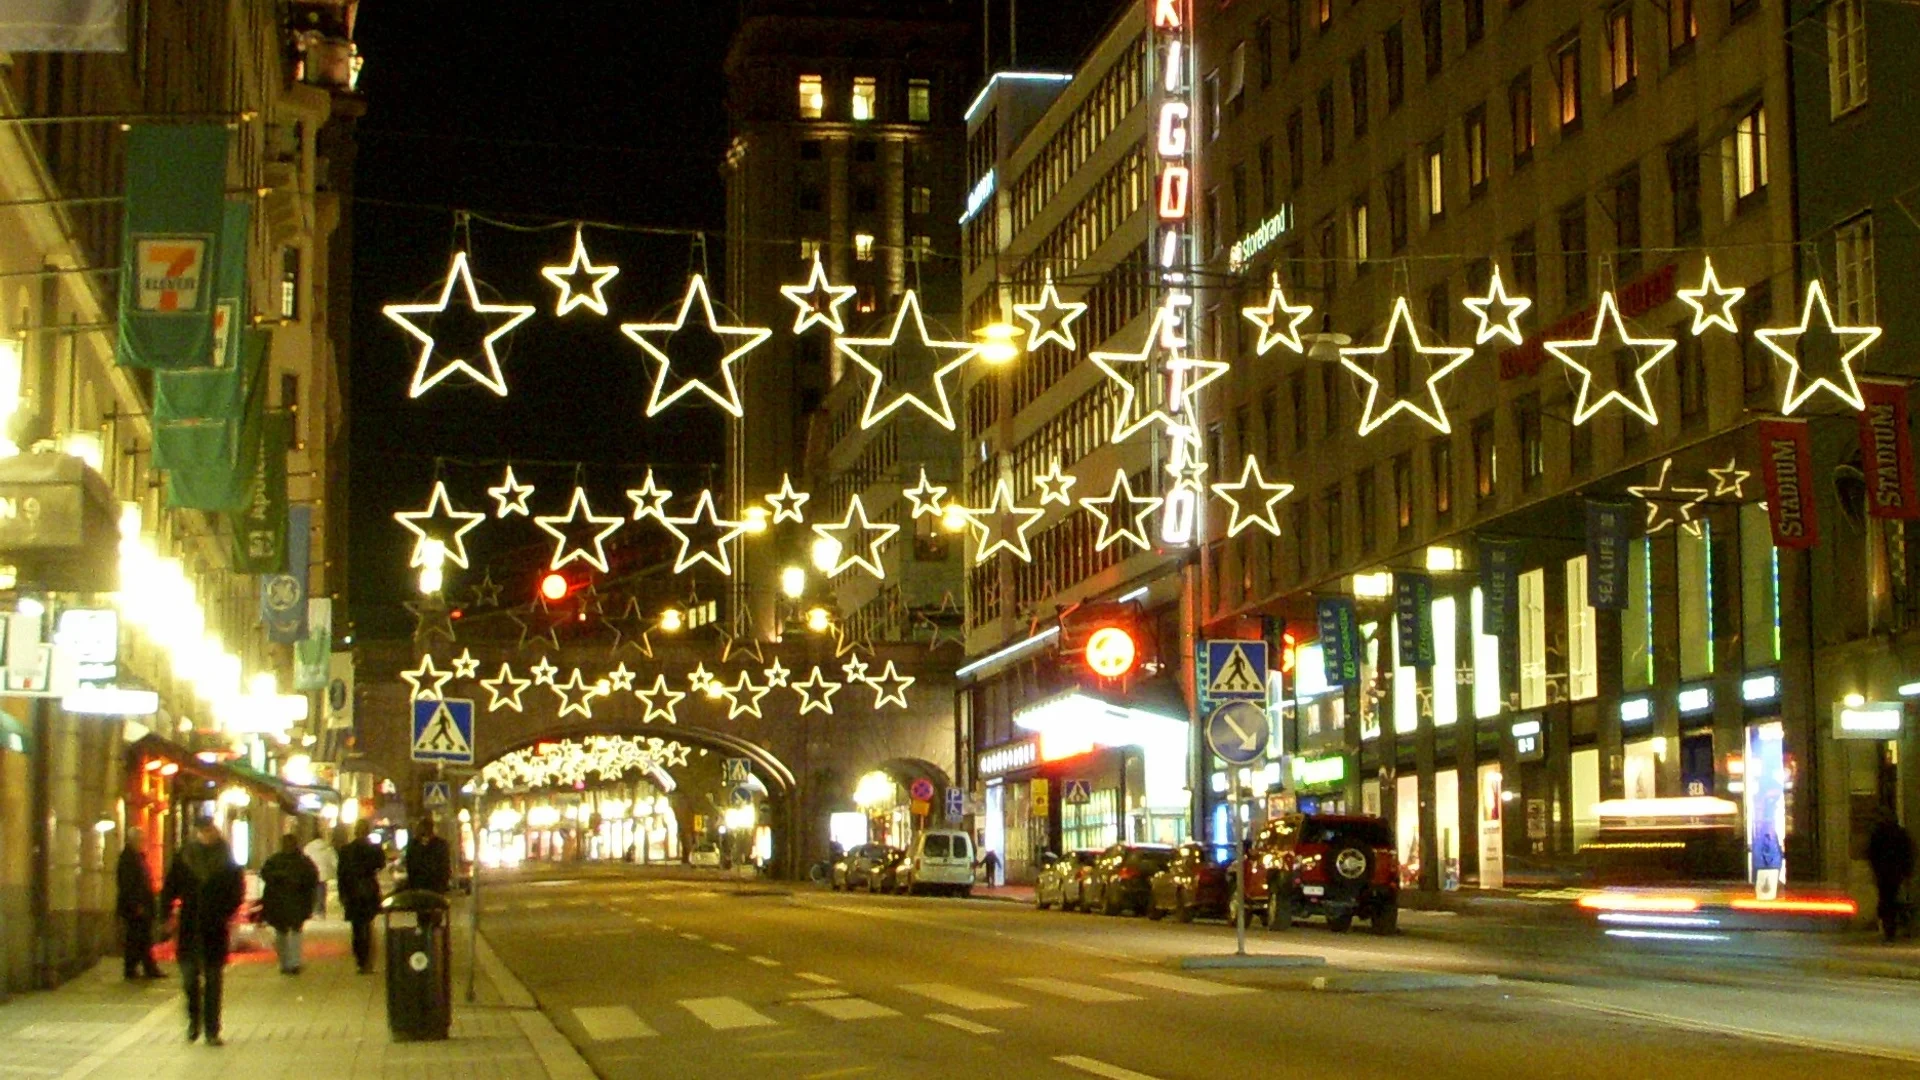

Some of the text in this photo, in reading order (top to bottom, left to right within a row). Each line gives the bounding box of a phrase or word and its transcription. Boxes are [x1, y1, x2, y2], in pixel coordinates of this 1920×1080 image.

[147, 245, 197, 313] 7
[1771, 439, 1804, 537] STADIUM
[1869, 404, 1903, 507] STADIUM
[951, 789, 960, 800] P
